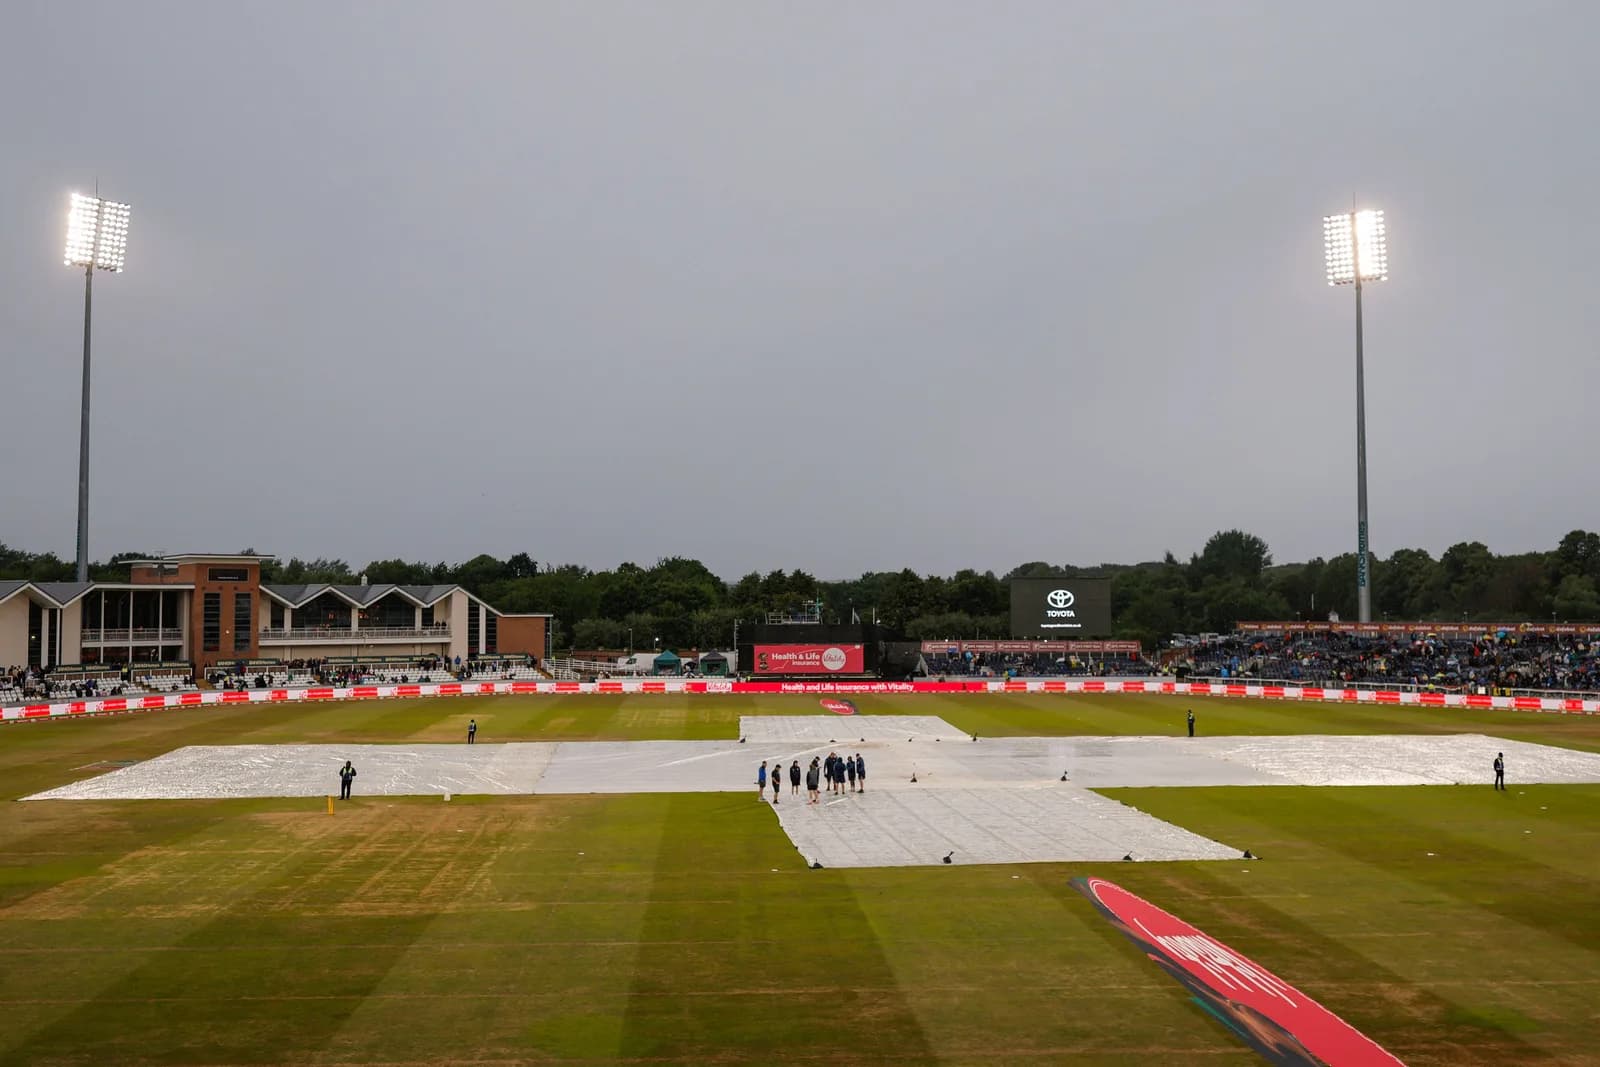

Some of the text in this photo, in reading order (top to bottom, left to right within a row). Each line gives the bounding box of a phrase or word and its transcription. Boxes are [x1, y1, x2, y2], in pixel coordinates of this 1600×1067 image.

[771, 653, 798, 661] Health
[805, 653, 820, 661] Life
[781, 682, 805, 691] Health
[805, 682, 820, 691] and
[821, 682, 834, 691] Life
[871, 682, 887, 691] with
[887, 682, 914, 692] Vitality
